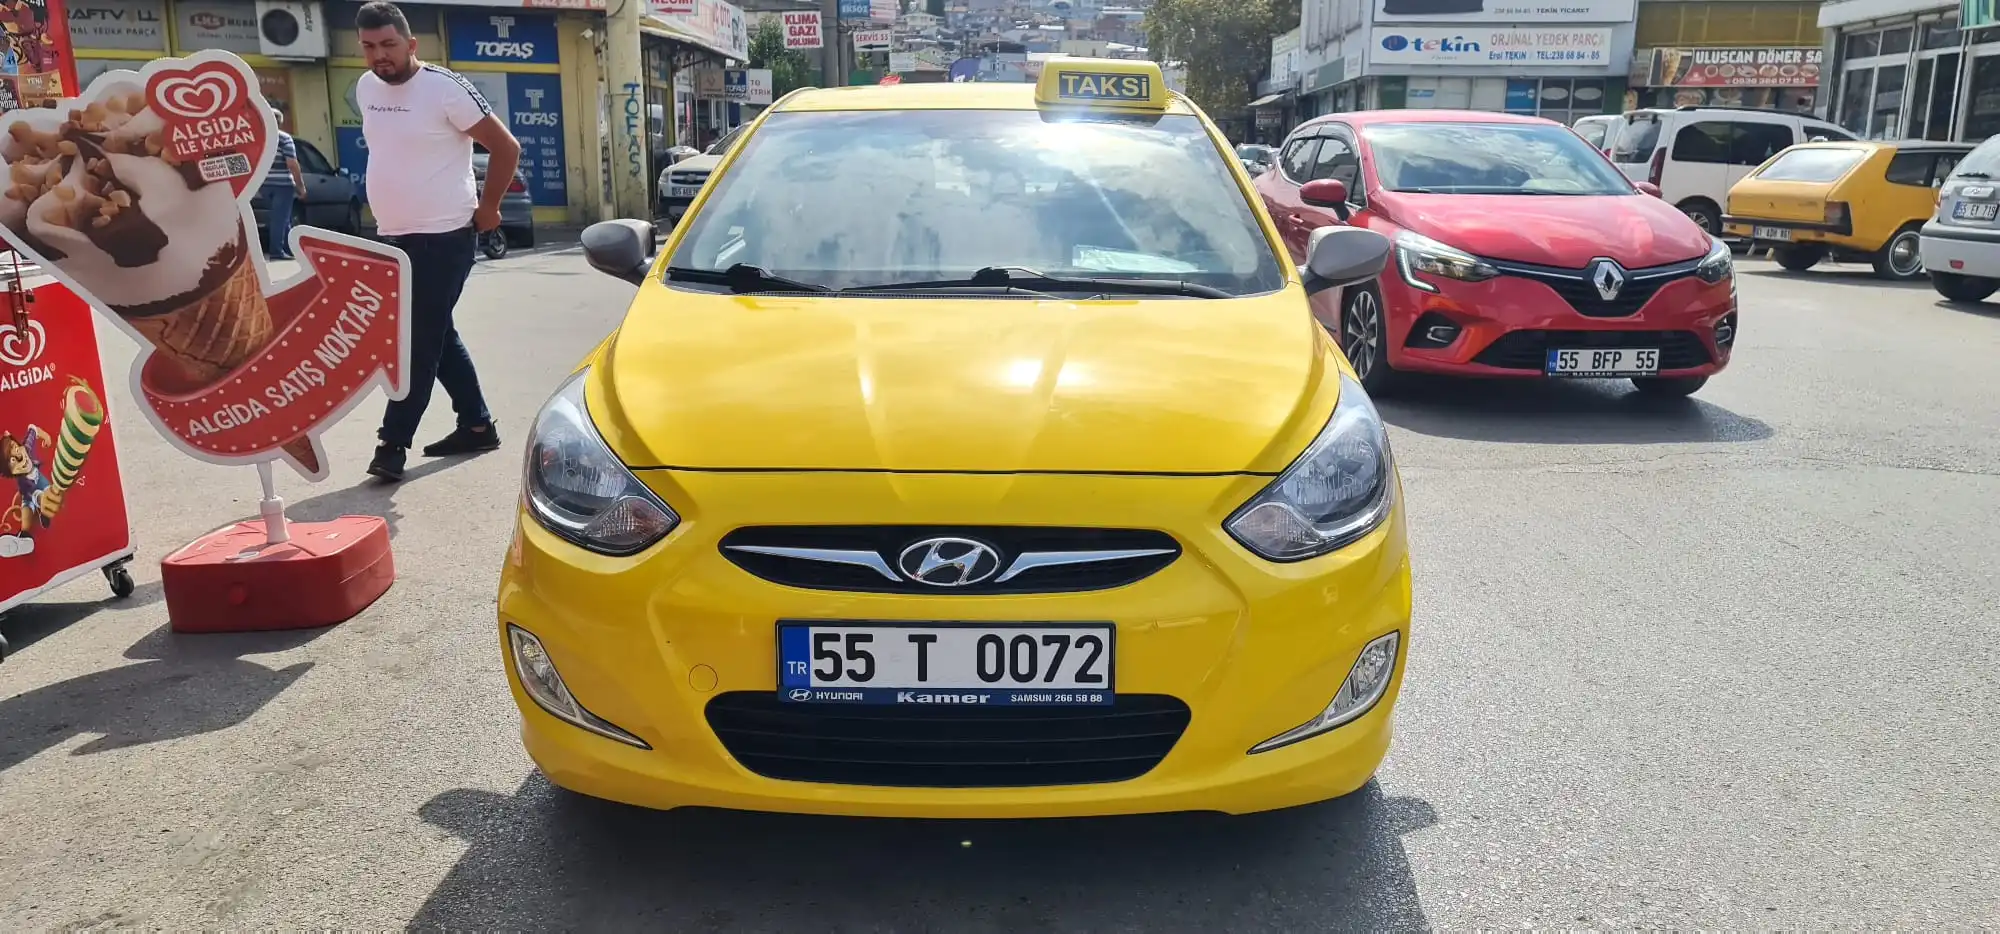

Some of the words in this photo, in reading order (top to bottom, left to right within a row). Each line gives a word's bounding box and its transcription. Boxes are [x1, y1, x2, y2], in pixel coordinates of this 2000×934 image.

[1536, 33, 1569, 46] YEDEK
[475, 41, 535, 59] TOFAŞ
[1758, 49, 1802, 64] DÖNER
[514, 111, 558, 127] TOFAŞ
[200, 130, 256, 151] KAZAN
[264, 359, 326, 409] SATIŞ
[313, 279, 383, 370] NOKTASI
[1559, 351, 1579, 370] 55
[1592, 351, 1622, 370] BFP
[1636, 351, 1656, 369] 55
[813, 633, 875, 682] 55
[908, 634, 938, 682] T
[976, 633, 1104, 683] 0072
[787, 661, 807, 674] TR
[816, 692, 863, 701] HYUNDAI
[897, 691, 991, 703] Kamer
[1011, 694, 1052, 702] SAMSUN
[1055, 694, 1072, 702] 266
